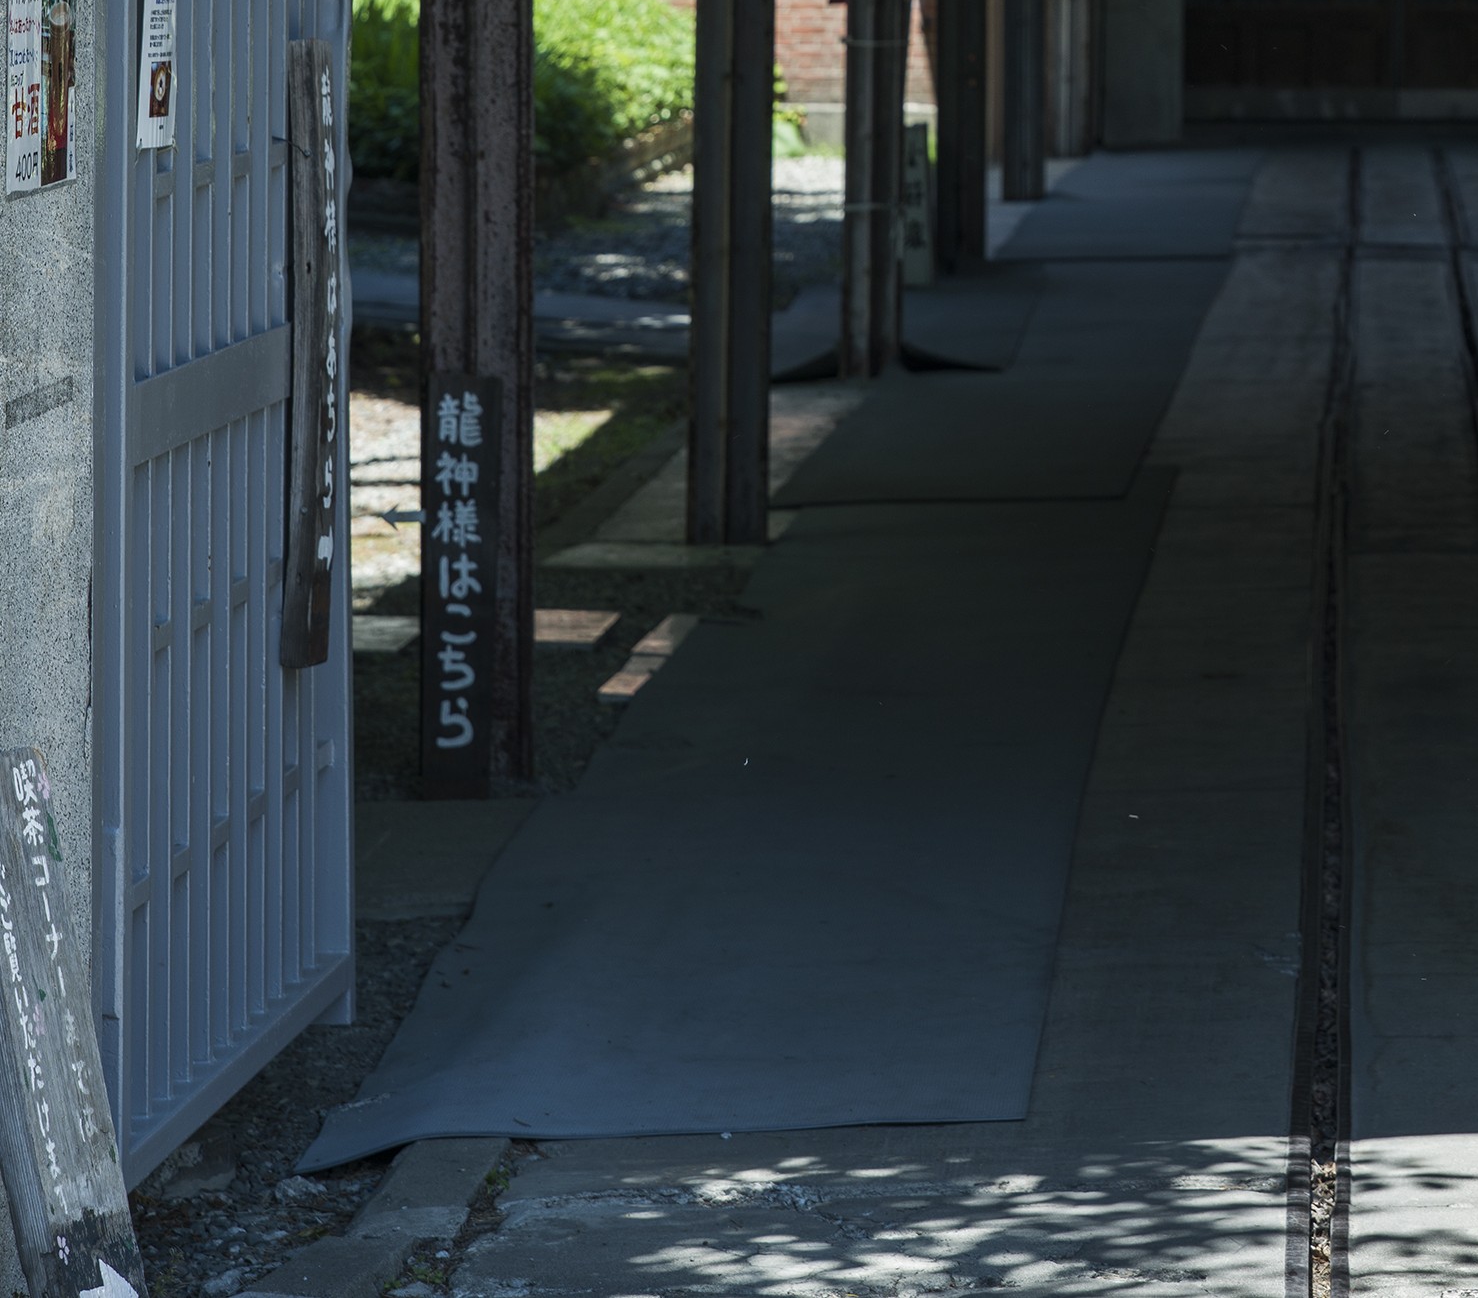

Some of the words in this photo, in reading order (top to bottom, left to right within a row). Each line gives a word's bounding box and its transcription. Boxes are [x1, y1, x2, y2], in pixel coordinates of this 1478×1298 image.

[12, 83, 40, 139] 甘酒
[15, 151, 39, 183] 400円
[432, 391, 484, 750] 龍神様はこちら
